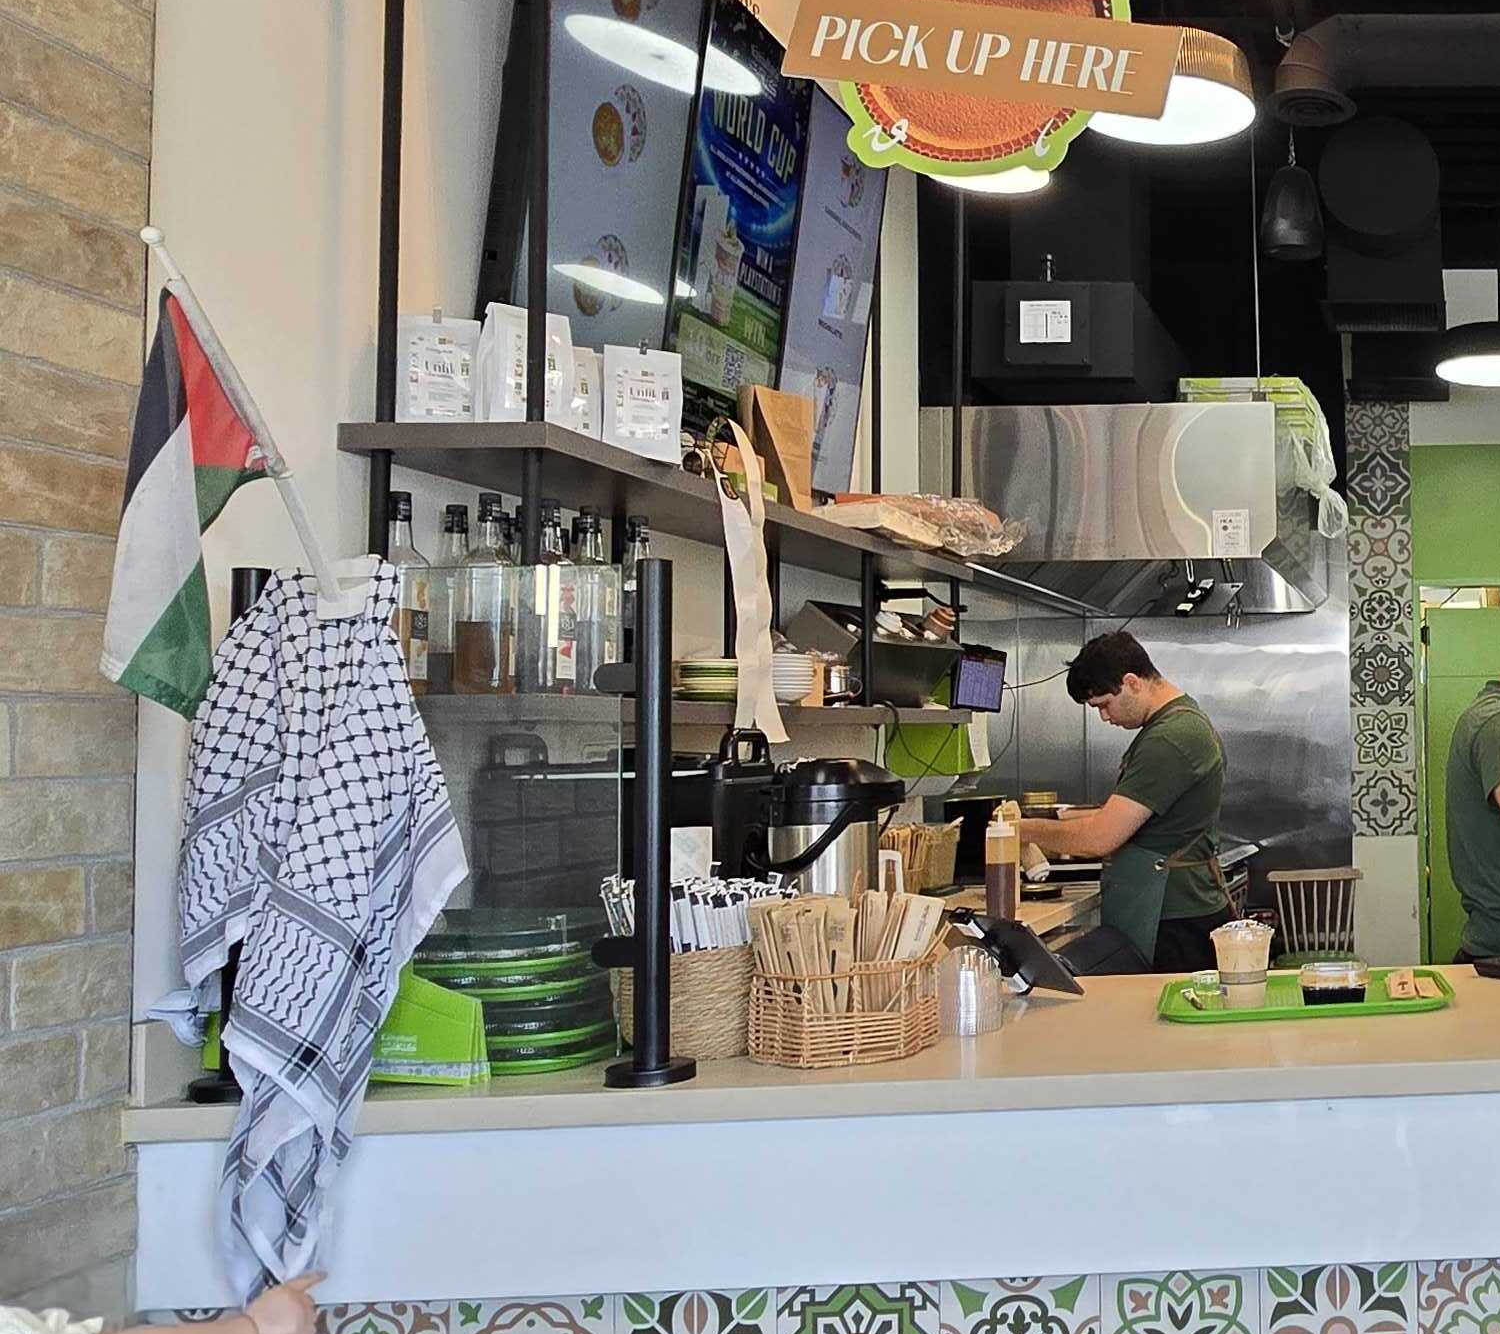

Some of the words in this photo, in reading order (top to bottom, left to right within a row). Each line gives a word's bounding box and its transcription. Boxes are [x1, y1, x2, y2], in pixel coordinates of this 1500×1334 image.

[810, 15, 935, 69] PICK
[946, 30, 1010, 76] UP
[1019, 38, 1143, 95] HERE
[713, 90, 766, 155] WORLD
[767, 124, 798, 183] CUP
